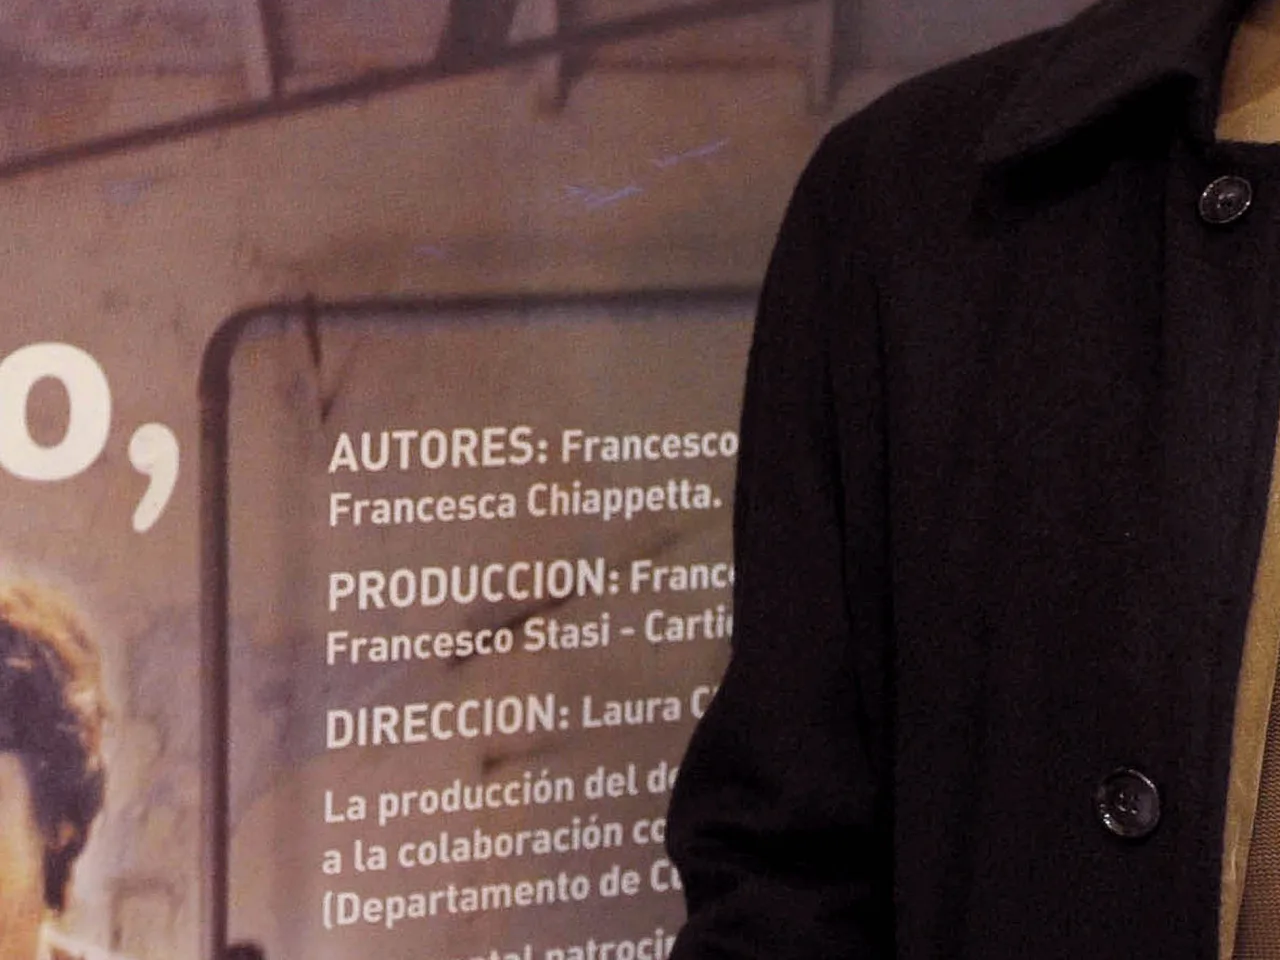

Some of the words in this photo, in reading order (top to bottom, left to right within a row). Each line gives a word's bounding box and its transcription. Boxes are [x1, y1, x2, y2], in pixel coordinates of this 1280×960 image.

[328, 425, 549, 474] AUTORES:
[561, 429, 739, 463] Francesco
[329, 492, 517, 527] Francesca
[527, 479, 723, 521] Chiappetta.
[328, 557, 620, 612] PRODUCCION:
[326, 627, 514, 665] Francesco
[523, 613, 610, 652] Stasi
[326, 693, 569, 750] DIRECCION:
[582, 694, 681, 729] Laura
[323, 791, 366, 824] La
[378, 769, 575, 826] producción
[585, 762, 639, 798] del
[322, 851, 342, 875] a
[354, 839, 387, 873] la
[398, 814, 623, 869] colaboración
[321, 873, 590, 930] (Departamento
[600, 865, 640, 898] de
